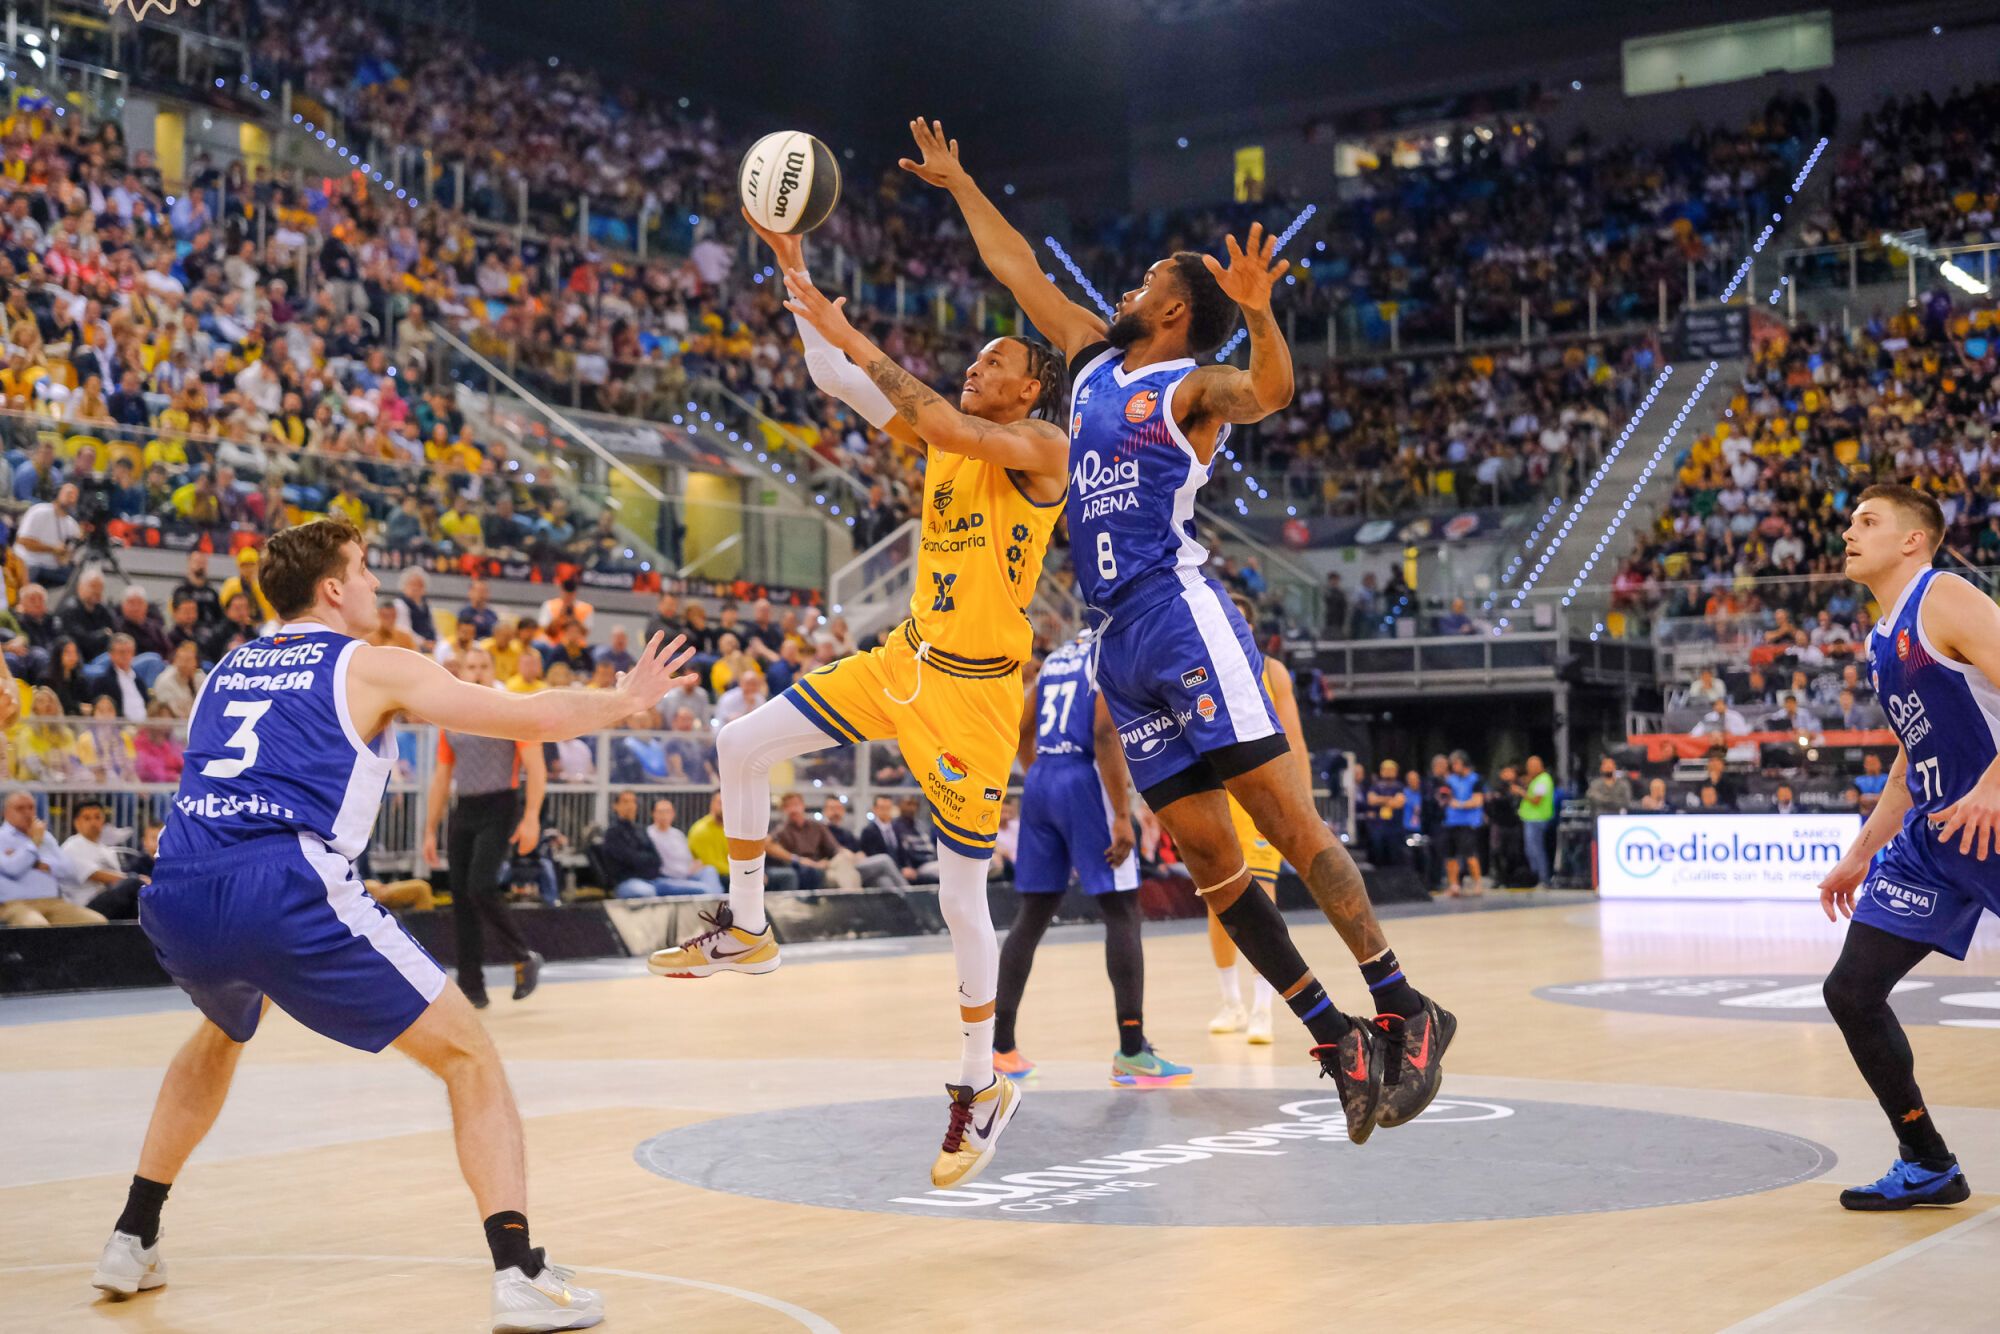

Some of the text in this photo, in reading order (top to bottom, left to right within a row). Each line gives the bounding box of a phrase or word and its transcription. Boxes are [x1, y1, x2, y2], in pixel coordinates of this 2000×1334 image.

[773, 151, 806, 218] Wilson
[1071, 450, 1140, 501] Roig
[1081, 491, 1140, 524] ARENA
[1096, 531, 1118, 581] 8
[228, 642, 330, 669] REUVERS
[1185, 674, 1203, 686] acb
[1039, 680, 1078, 738] 37
[199, 699, 273, 779] 3
[1120, 716, 1175, 749] PULEVA
[928, 772, 966, 803] Poema
[984, 793, 998, 801] acb
[1625, 832, 1842, 862] mediolanum
[1876, 879, 1930, 908] PULEVA
[998, 1181, 1159, 1212] BANCO
